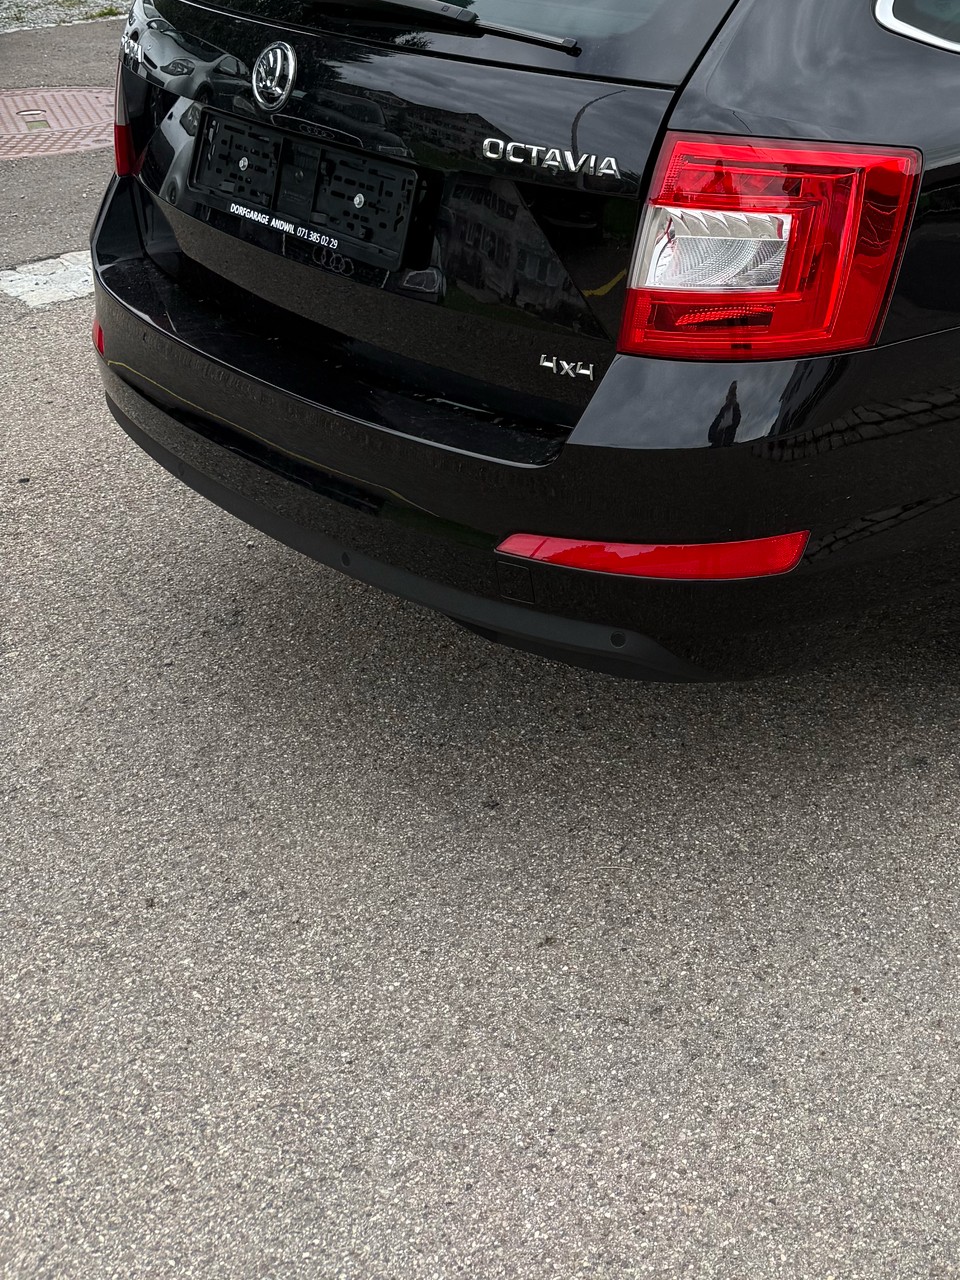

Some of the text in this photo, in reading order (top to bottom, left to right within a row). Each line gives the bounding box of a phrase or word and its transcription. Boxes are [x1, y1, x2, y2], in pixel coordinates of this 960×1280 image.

[482, 137, 622, 180] OCTAVIA
[230, 203, 339, 249] DORFGARAGE ANDWIL 071 385 02 29
[539, 354, 595, 382] 4x4
